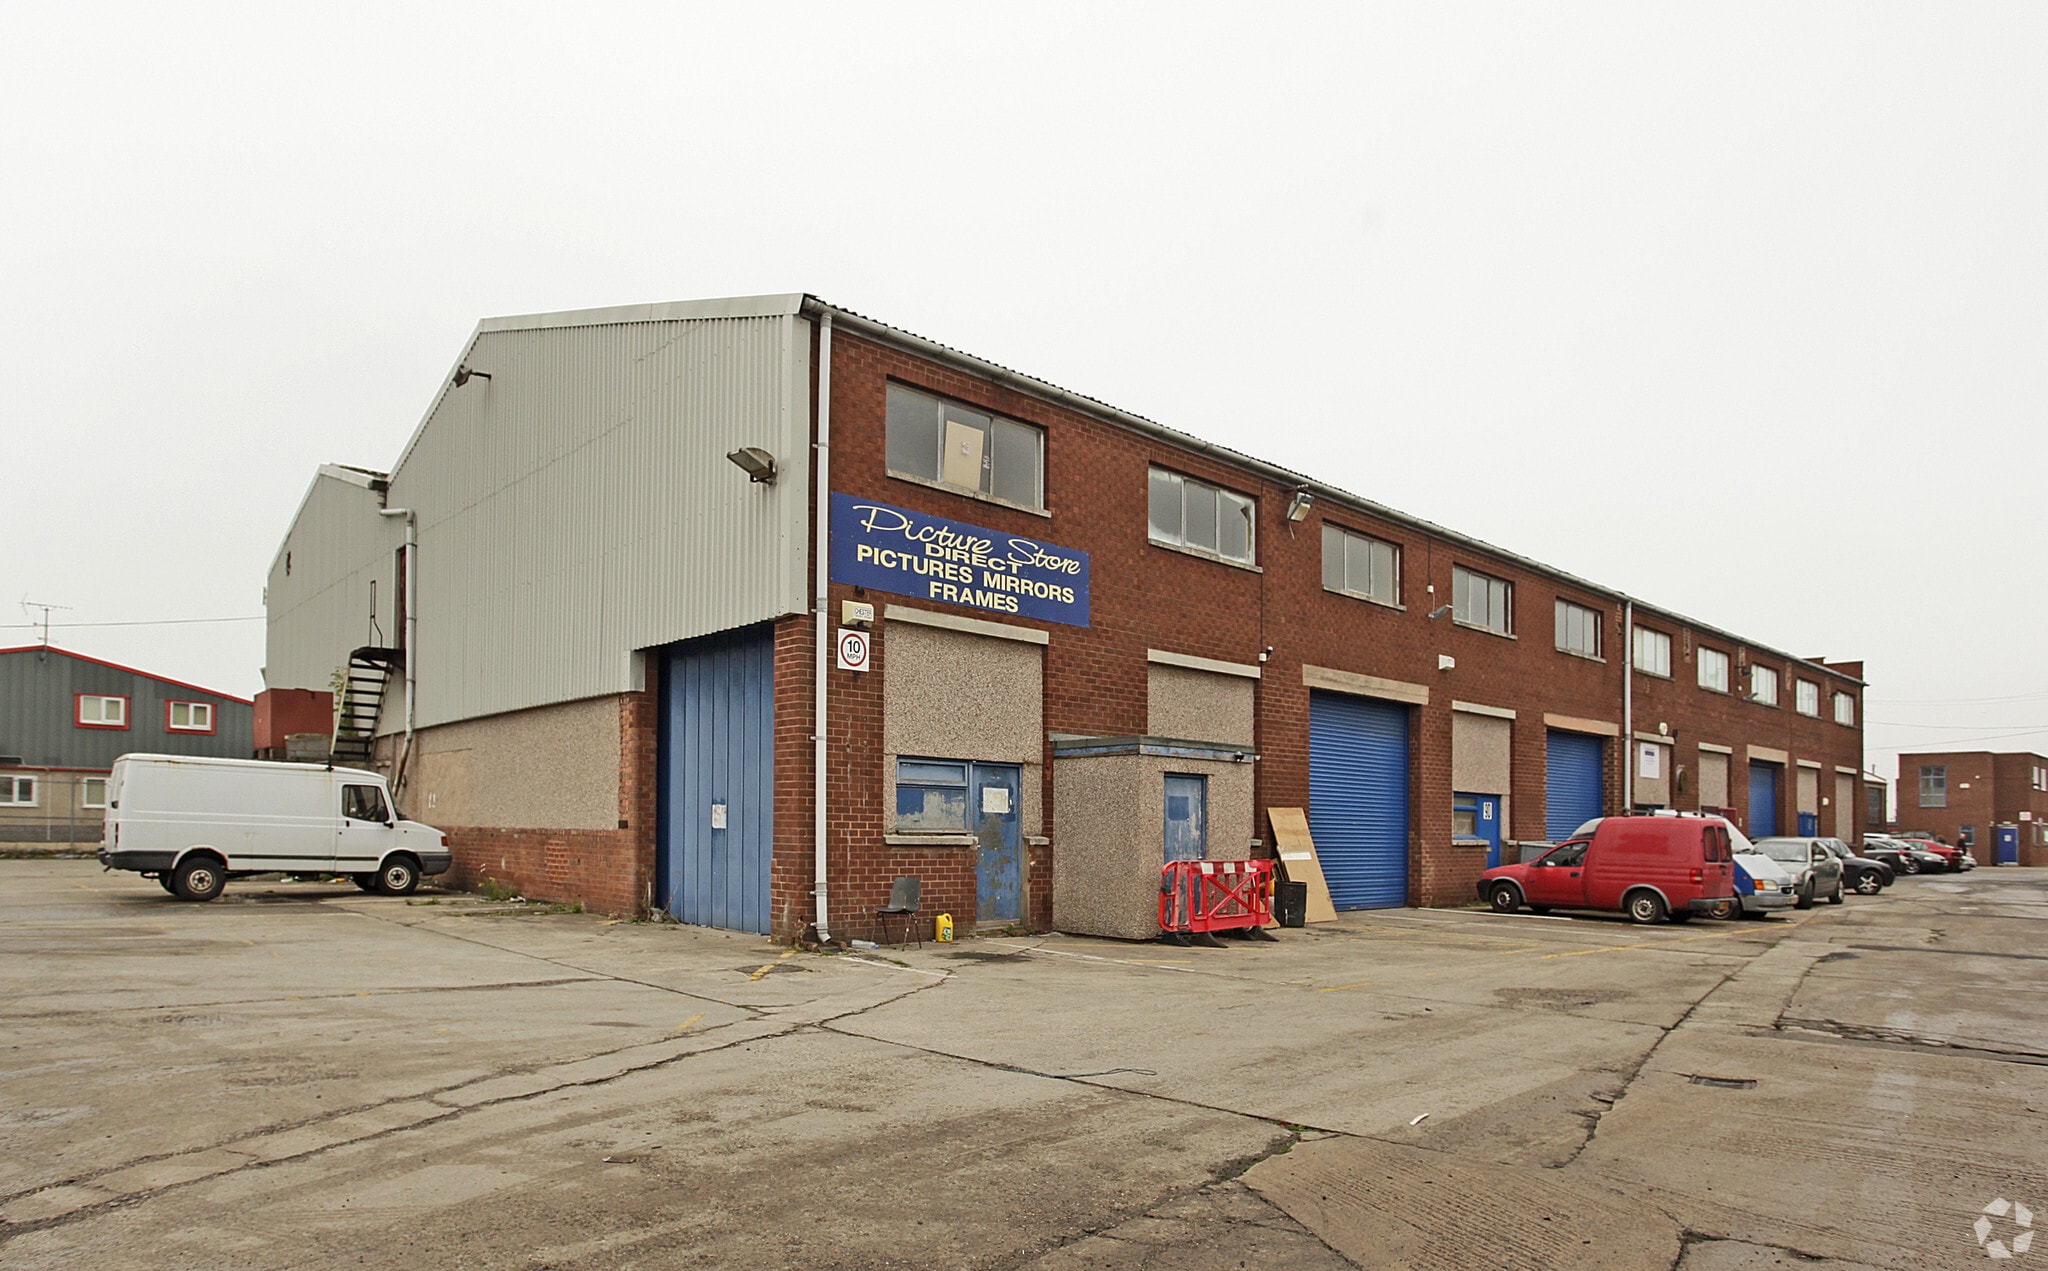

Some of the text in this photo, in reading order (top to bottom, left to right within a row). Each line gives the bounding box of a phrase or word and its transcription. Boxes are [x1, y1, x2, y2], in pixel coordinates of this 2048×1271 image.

[852, 505, 1081, 575] Picture Store
[857, 544, 1075, 604] PICTURES MIRRORS
[925, 543, 1022, 574] DIRECT
[929, 581, 1019, 613] FRAMES
[848, 639, 860, 654] 10
